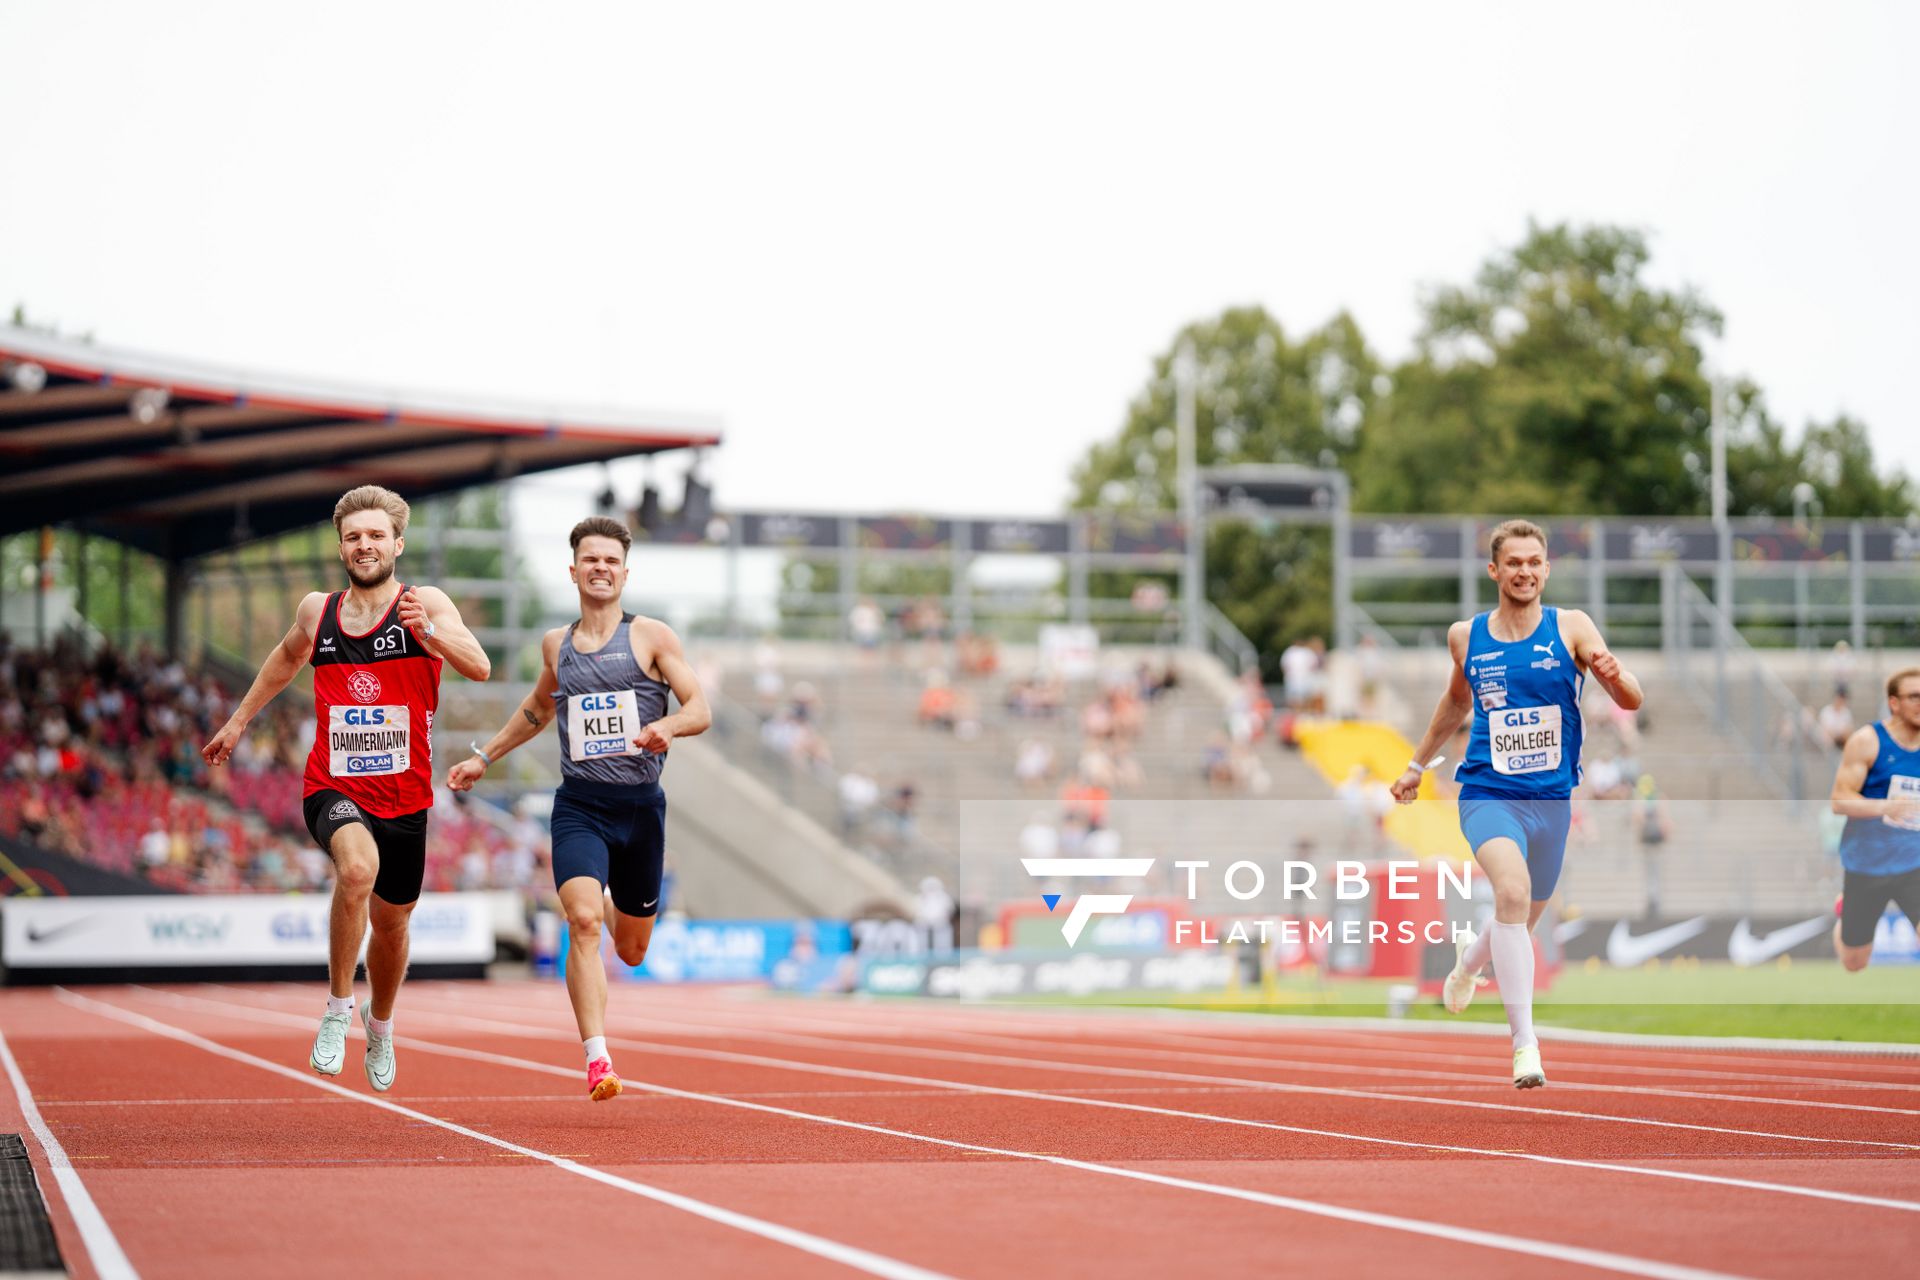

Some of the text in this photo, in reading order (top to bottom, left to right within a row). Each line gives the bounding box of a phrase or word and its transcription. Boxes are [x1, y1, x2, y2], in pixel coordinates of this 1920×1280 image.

[373, 634, 396, 651] OS
[584, 716, 624, 736] KLEI
[332, 730, 407, 752] DAMMERMANN
[601, 740, 625, 749] PLAN
[1495, 730, 1558, 752] SCHLEGEL
[365, 757, 391, 767] PLAN
[1524, 754, 1546, 763] PLAN
